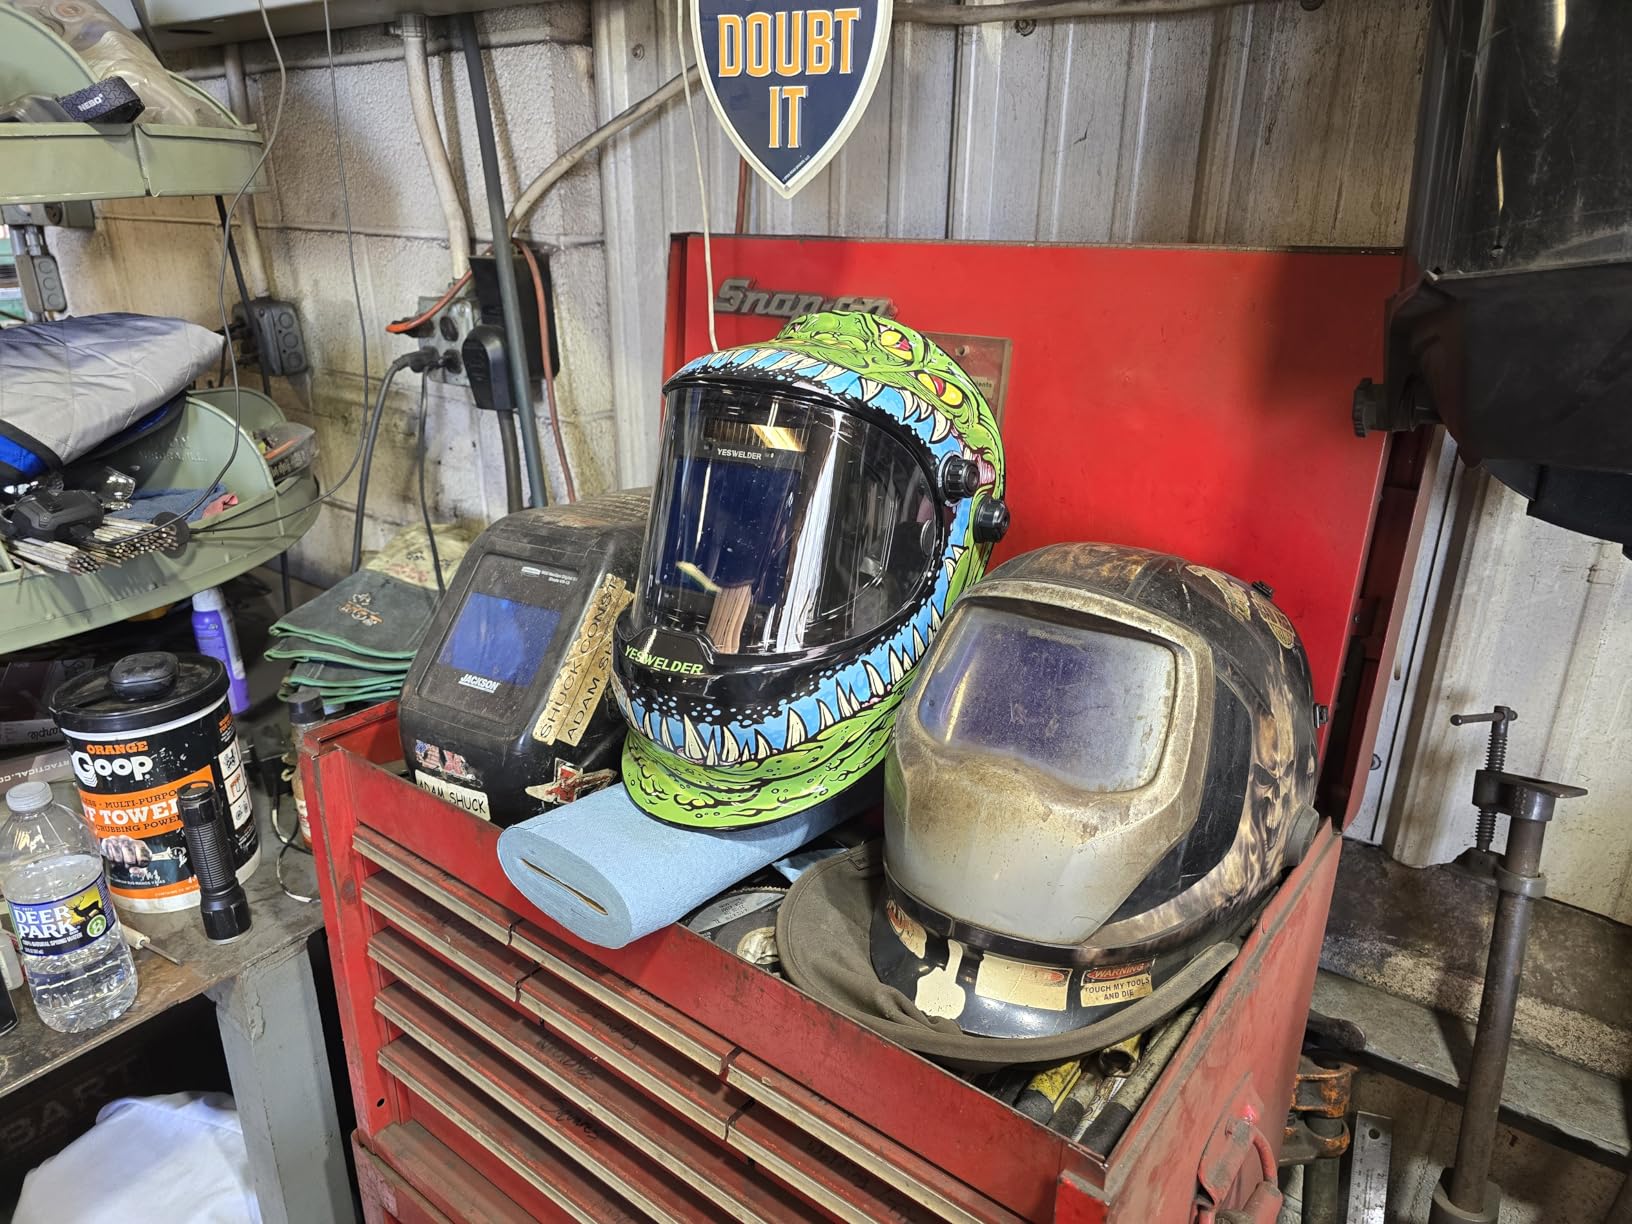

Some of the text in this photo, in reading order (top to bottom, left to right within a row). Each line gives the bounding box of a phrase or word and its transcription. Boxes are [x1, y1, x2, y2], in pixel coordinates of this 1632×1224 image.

[717, 7, 861, 77] DOUBT
[769, 86, 808, 149] IT
[717, 447, 762, 460] YESWELDER
[625, 645, 704, 675] YESWELDER
[459, 673, 500, 692] JACKSON
[540, 659, 582, 739] SHUCK
[567, 677, 601, 741] ADAM
[86, 741, 149, 755] ORANGE
[71, 750, 153, 787] Goop
[105, 789, 177, 808] MULTI-PURPO
[449, 791, 487, 814] SHUCK
[95, 824, 142, 833] CRUBBING
[13, 905, 71, 924] DEER
[18, 919, 78, 939] PARK
[1094, 963, 1146, 978] WARNING
[1085, 985, 1111, 994] TOUCH
[1127, 977, 1150, 987] TOOLS
[1104, 989, 1134, 1001] AND DIE
